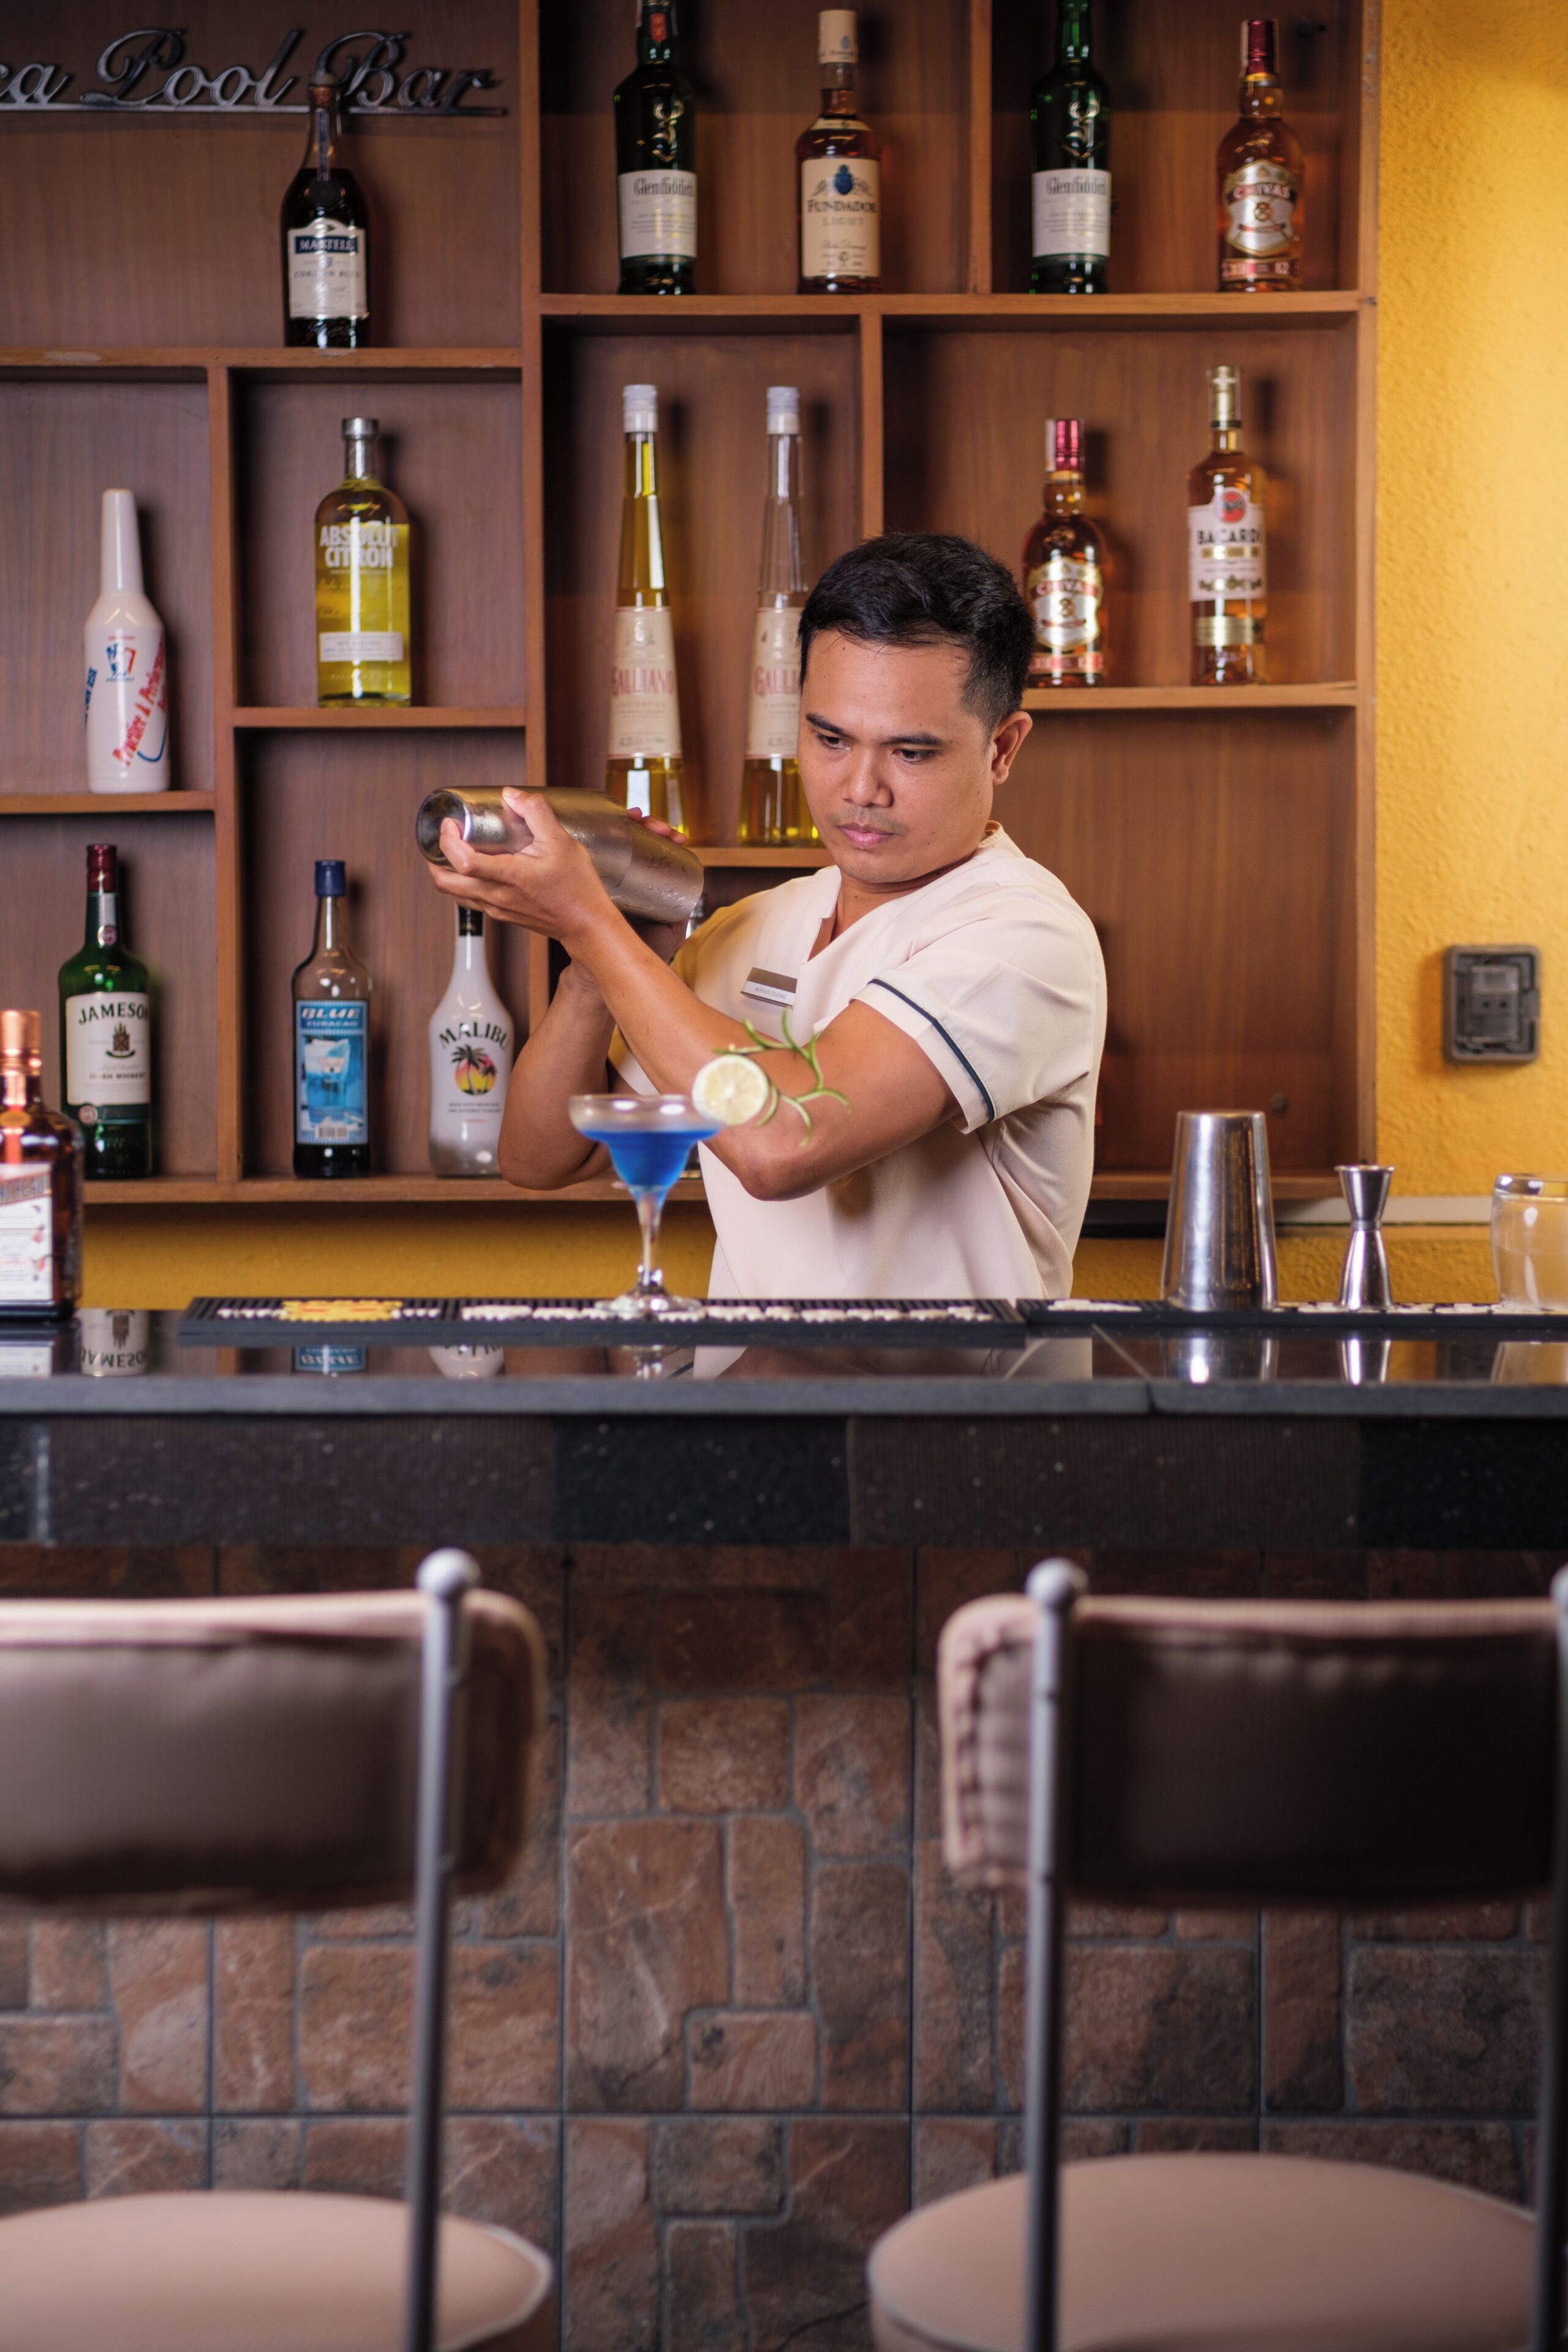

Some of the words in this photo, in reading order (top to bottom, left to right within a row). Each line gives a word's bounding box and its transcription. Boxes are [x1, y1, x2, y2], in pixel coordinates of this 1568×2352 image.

[0, 64, 69, 105] a
[80, 29, 302, 105] Pool
[315, 31, 499, 106] Bar
[1233, 183, 1291, 199] CIVAS
[807, 199, 876, 213] FUNDADOR
[823, 217, 864, 226] LIGHT
[300, 238, 355, 251] MARTELL
[319, 524, 401, 548] ABSOLUT
[325, 546, 394, 568] CITRON
[301, 1007, 360, 1019] BLUE
[439, 1020, 510, 1050] MALIBU
